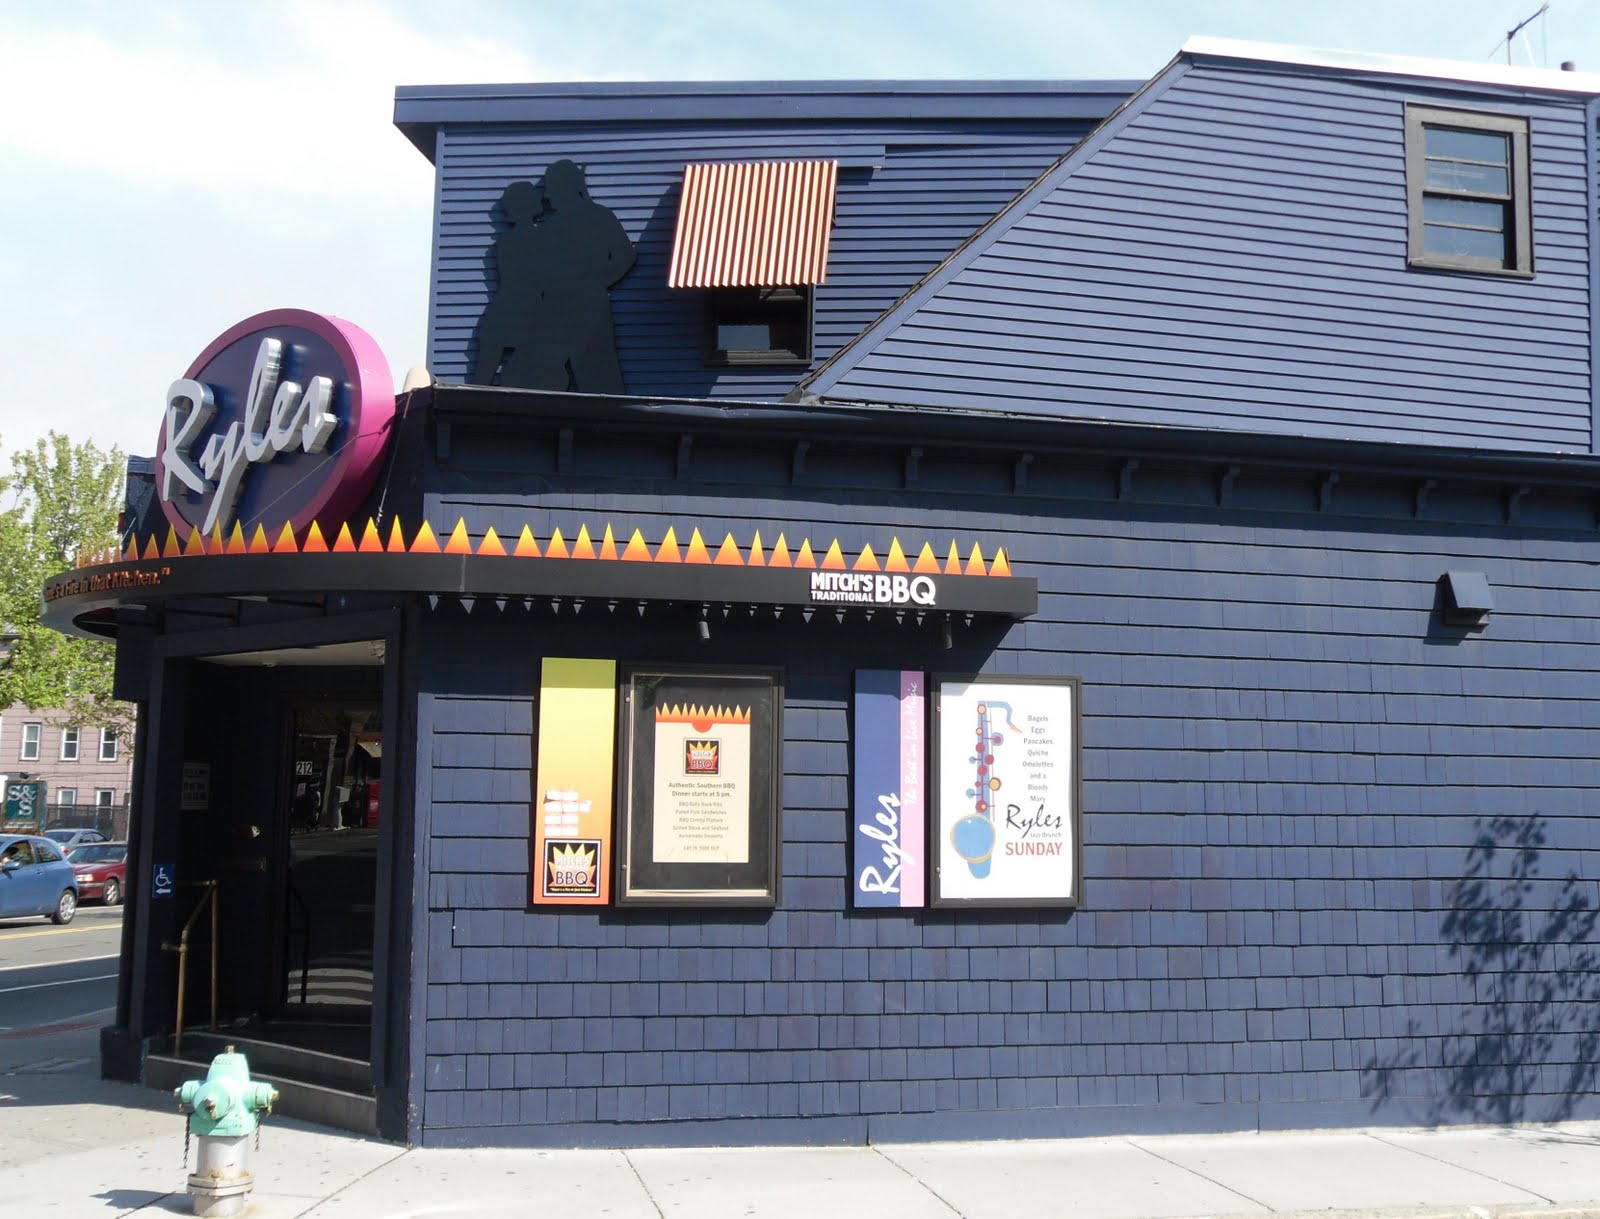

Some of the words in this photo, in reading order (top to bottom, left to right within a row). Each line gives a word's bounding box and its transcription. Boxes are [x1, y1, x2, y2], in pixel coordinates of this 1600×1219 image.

[162, 337, 338, 536] Ryles
[811, 572, 874, 592] MITCH'S
[875, 575, 936, 605] BBQ
[811, 590, 874, 602] TRADITIONAL
[1027, 715, 1049, 723] Bagels
[1031, 726, 1046, 735] Eggs
[1027, 749, 1049, 757] Quiche
[297, 762, 312, 775] 212
[692, 759, 713, 769] BBQ
[723, 782, 735, 790] BBQ
[1027, 783, 1049, 792] Bloody
[1030, 795, 1046, 803] Mary
[1005, 804, 1063, 839] Ryles
[859, 792, 915, 895] Ryles
[1005, 841, 1063, 856] SUNDAY
[555, 870, 589, 886] BBQ
